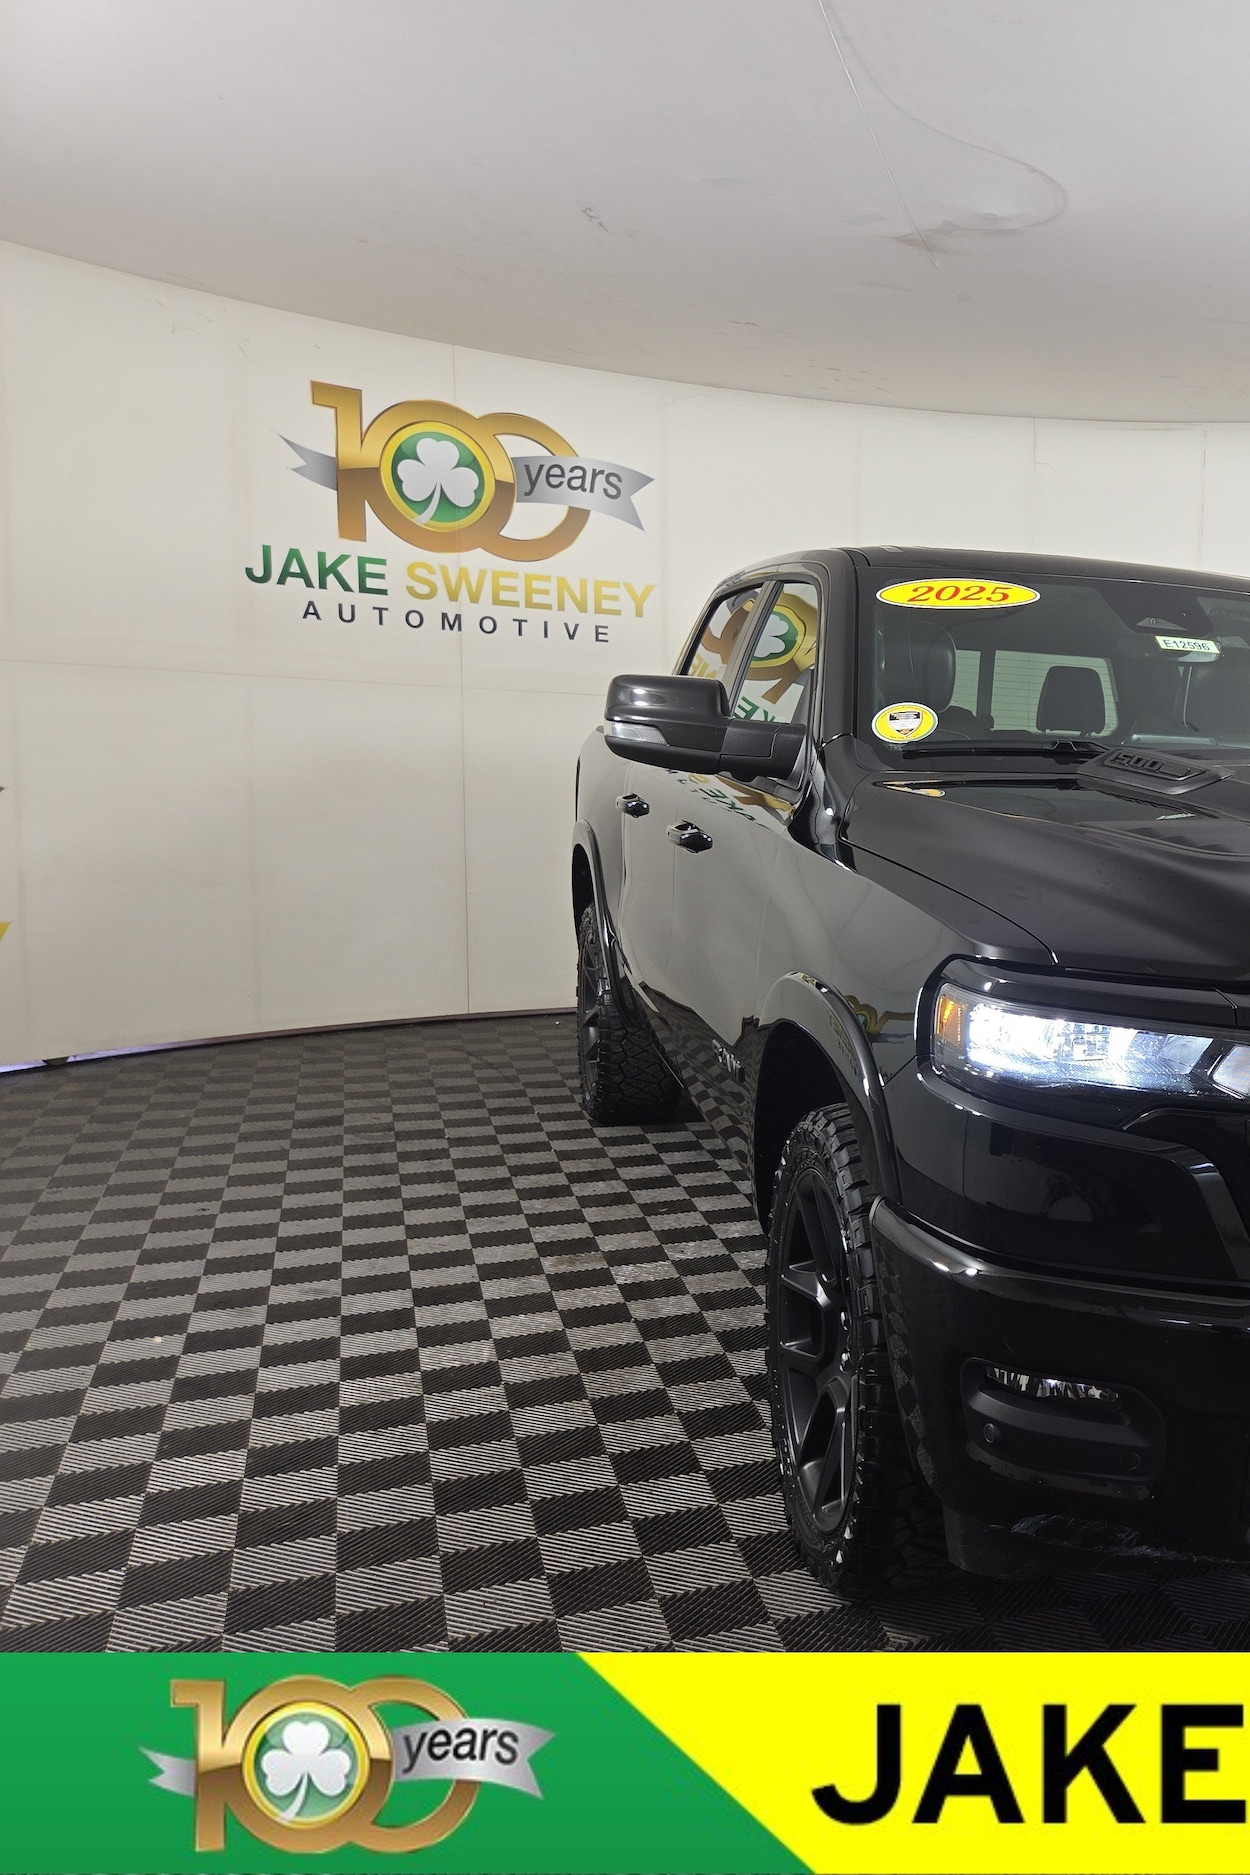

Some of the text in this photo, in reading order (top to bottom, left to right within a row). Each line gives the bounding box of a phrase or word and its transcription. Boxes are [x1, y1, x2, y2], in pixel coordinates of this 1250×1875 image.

[523, 457, 624, 500] years
[245, 544, 656, 619] JAKE SWEENEY
[907, 585, 1014, 602] 2025
[302, 600, 609, 643] AUTOMOTIVE
[1162, 639, 1210, 651] E12596
